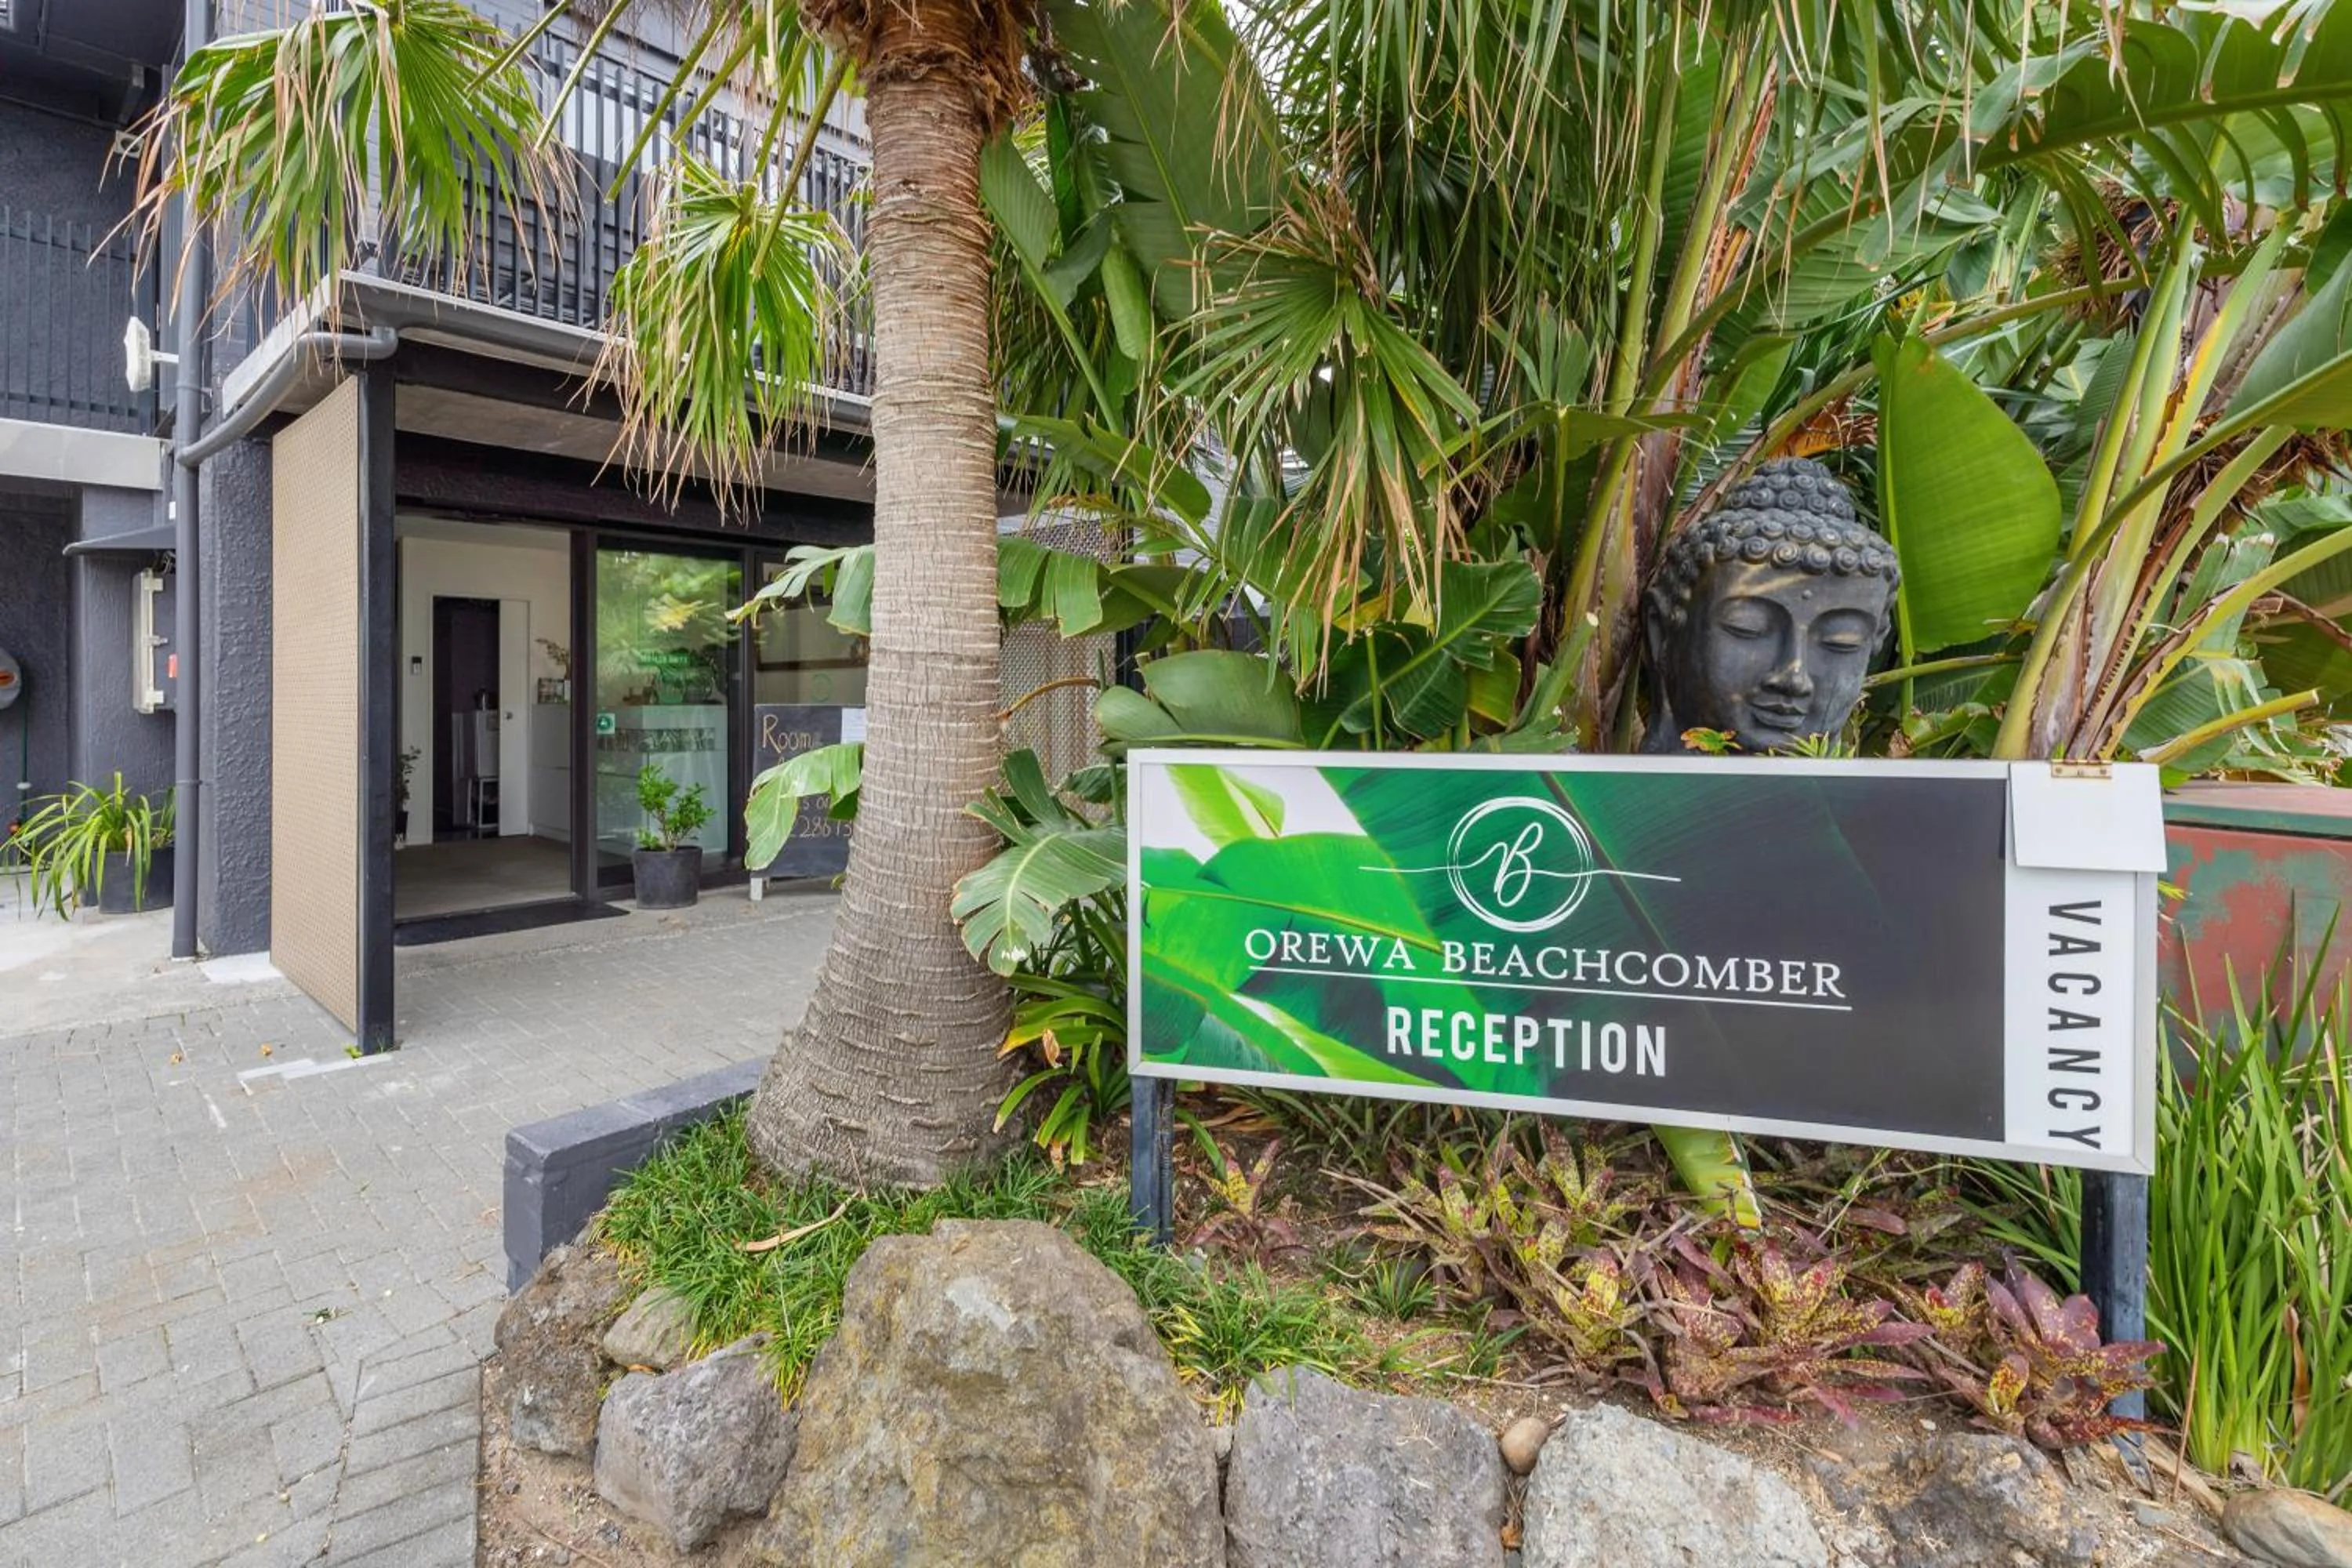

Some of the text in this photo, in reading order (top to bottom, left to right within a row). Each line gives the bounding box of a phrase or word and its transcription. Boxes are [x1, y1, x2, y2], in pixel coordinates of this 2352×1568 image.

[1244, 928, 1846, 999] OREWA BEACHCOMBER
[1386, 1006, 1668, 1077] RECEPTION
[2047, 899, 2103, 1151] VACANCY
